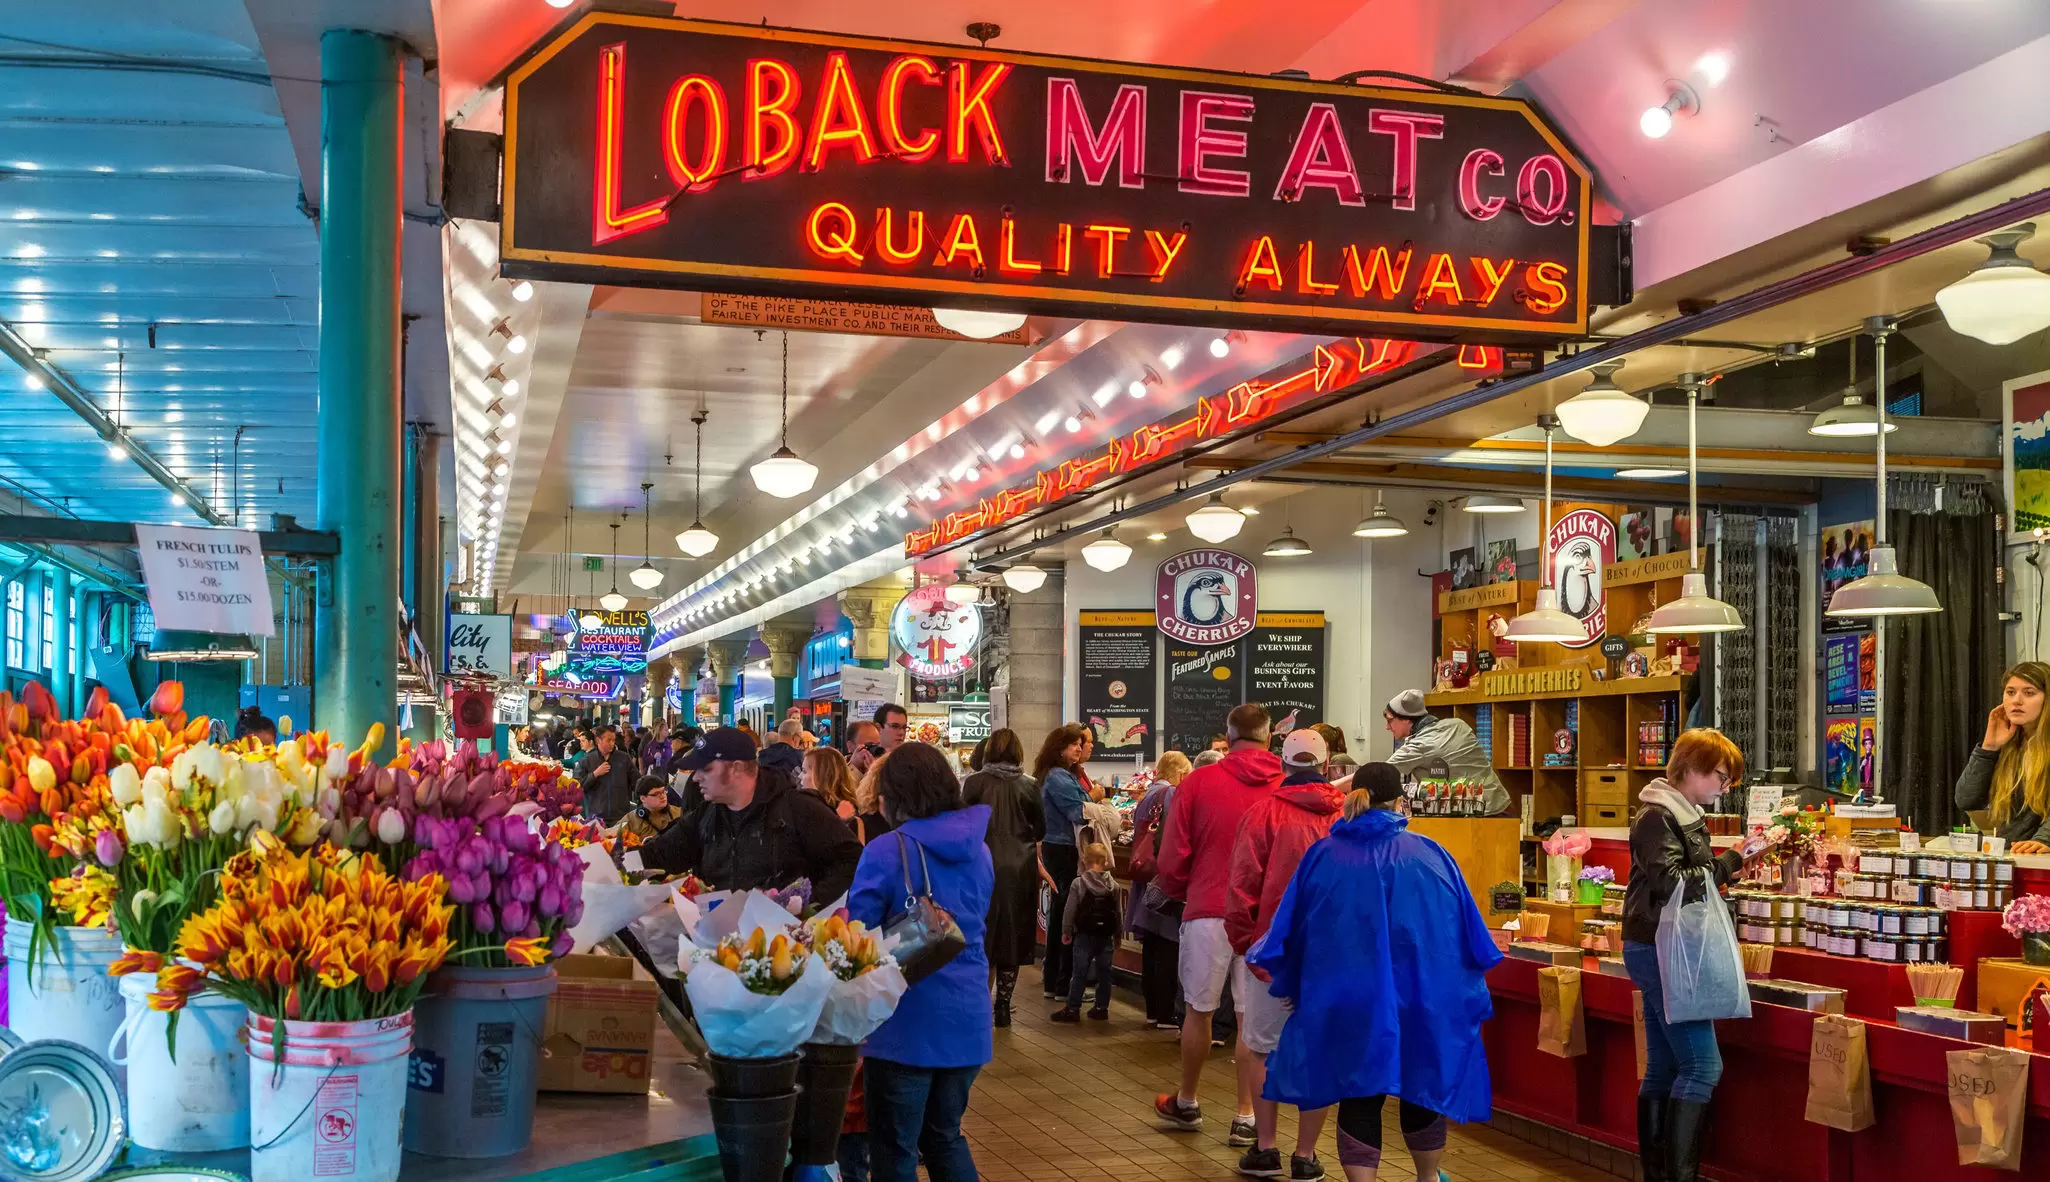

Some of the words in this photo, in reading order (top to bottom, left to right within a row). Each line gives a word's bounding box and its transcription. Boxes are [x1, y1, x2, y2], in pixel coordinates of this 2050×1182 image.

[1045, 77, 1444, 212] MEAT
[806, 201, 1187, 285] QUALITY
[1232, 235, 1568, 313] ALWAYS
[711, 299, 728, 308] OF
[736, 300, 758, 311] THE
[765, 303, 796, 313] PIKE
[803, 306, 848, 317] PLACE
[854, 309, 900, 321] PUBLIC
[904, 313, 936, 323] MARK
[712, 310, 761, 322] FAIRLEY
[766, 315, 839, 328] INVESTMENT
[865, 321, 886, 330] AND
[890, 323, 920, 332] THEIR
[1549, 514, 1611, 555] CHUKAR
[156, 540, 206, 554] FRENCH
[210, 543, 252, 555] TULIPS
[1164, 552, 1249, 578] CHUKAR
[1644, 554, 1705, 576] CHOCOLAE
[582, 634, 640, 644] COCKTAILS
[1162, 616, 1250, 641] CHERRIES
[1283, 635, 1302, 643] SHIP
[581, 643, 616, 651] WATER
[618, 643, 642, 651] VIEW
[1604, 643, 1623, 652] GIFTS
[909, 658, 966, 676] PRODUCE
[1171, 656, 1206, 682] FEATURED
[1203, 645, 1236, 673] SAMPLES
[1254, 667, 1291, 675] BUSINESS
[1291, 667, 1316, 675] GIFTS
[1256, 681, 1283, 689] EVENT
[1283, 681, 1314, 689] FAVORS
[1484, 673, 1525, 697] CHUKAR
[1527, 668, 1582, 694] CHERRIES
[1259, 701, 1273, 709] HAT
[1815, 1041, 1847, 1064] USED
